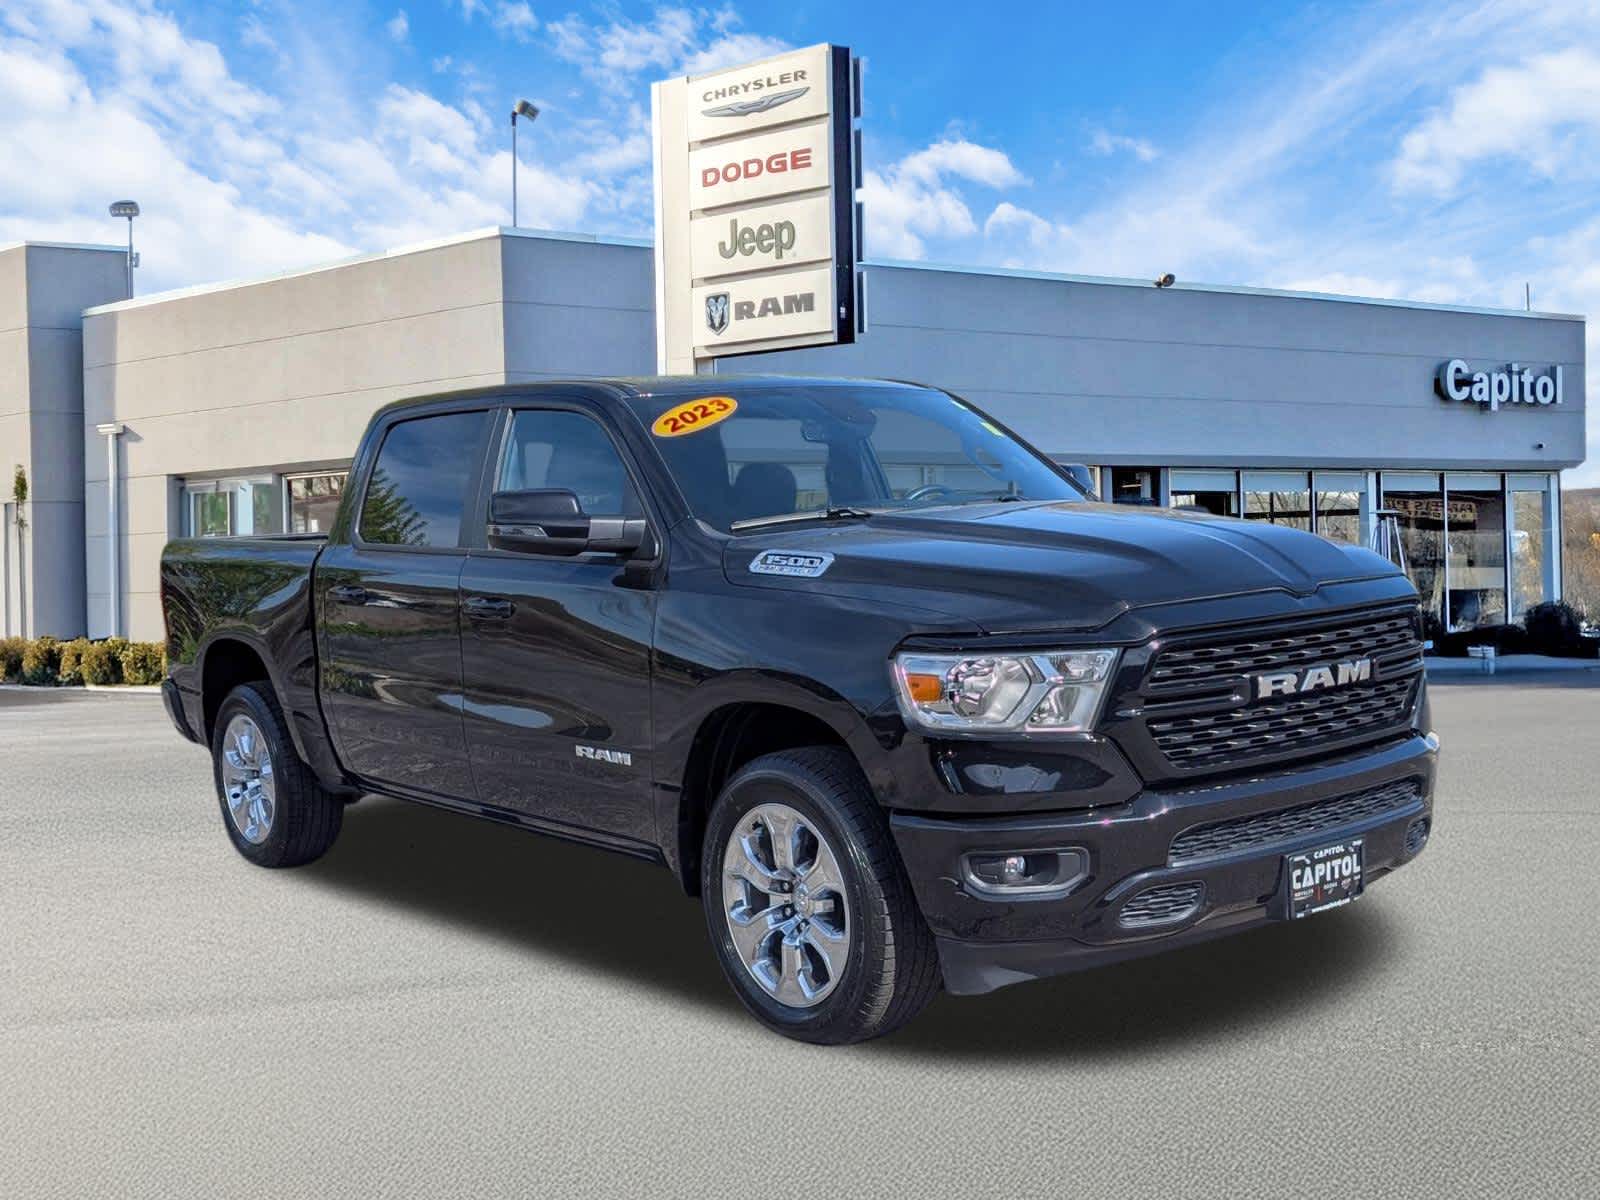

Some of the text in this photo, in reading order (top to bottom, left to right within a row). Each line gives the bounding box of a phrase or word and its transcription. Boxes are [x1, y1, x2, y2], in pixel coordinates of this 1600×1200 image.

[702, 69, 808, 103] CHRYSLER
[702, 148, 812, 188] DODGE
[718, 218, 796, 259] Jeep
[734, 292, 815, 321] RAM
[1446, 359, 1563, 411] Capitol
[663, 399, 730, 433] 2023
[765, 554, 822, 568] 1500
[1257, 657, 1372, 699] RAM
[575, 744, 632, 767] RAM
[1313, 844, 1345, 860] CAPITOL
[1292, 853, 1361, 890] CAPITOL
